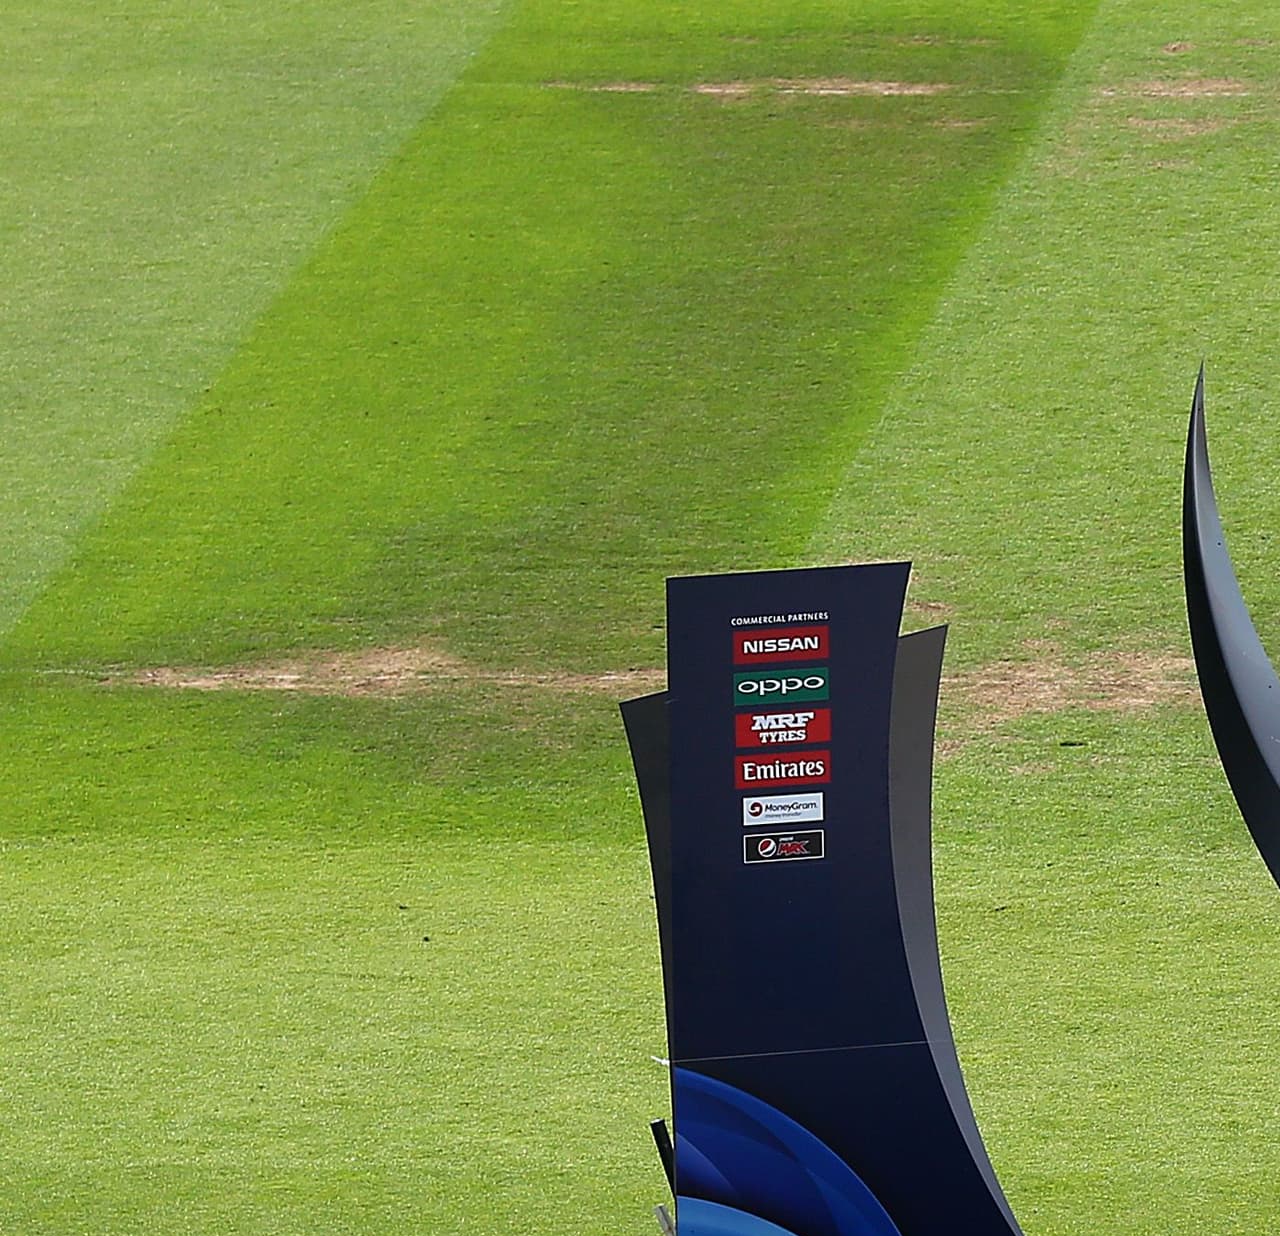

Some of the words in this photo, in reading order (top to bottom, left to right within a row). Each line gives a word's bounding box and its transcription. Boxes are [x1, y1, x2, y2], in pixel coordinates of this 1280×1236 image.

[731, 614, 786, 626] COMMERCIAL
[787, 611, 829, 622] PARTNERS
[743, 636, 819, 654] NISSAN
[738, 676, 825, 696] oppo
[751, 711, 814, 730] MRF
[759, 729, 807, 744] TYRES
[743, 760, 825, 780] Emirates
